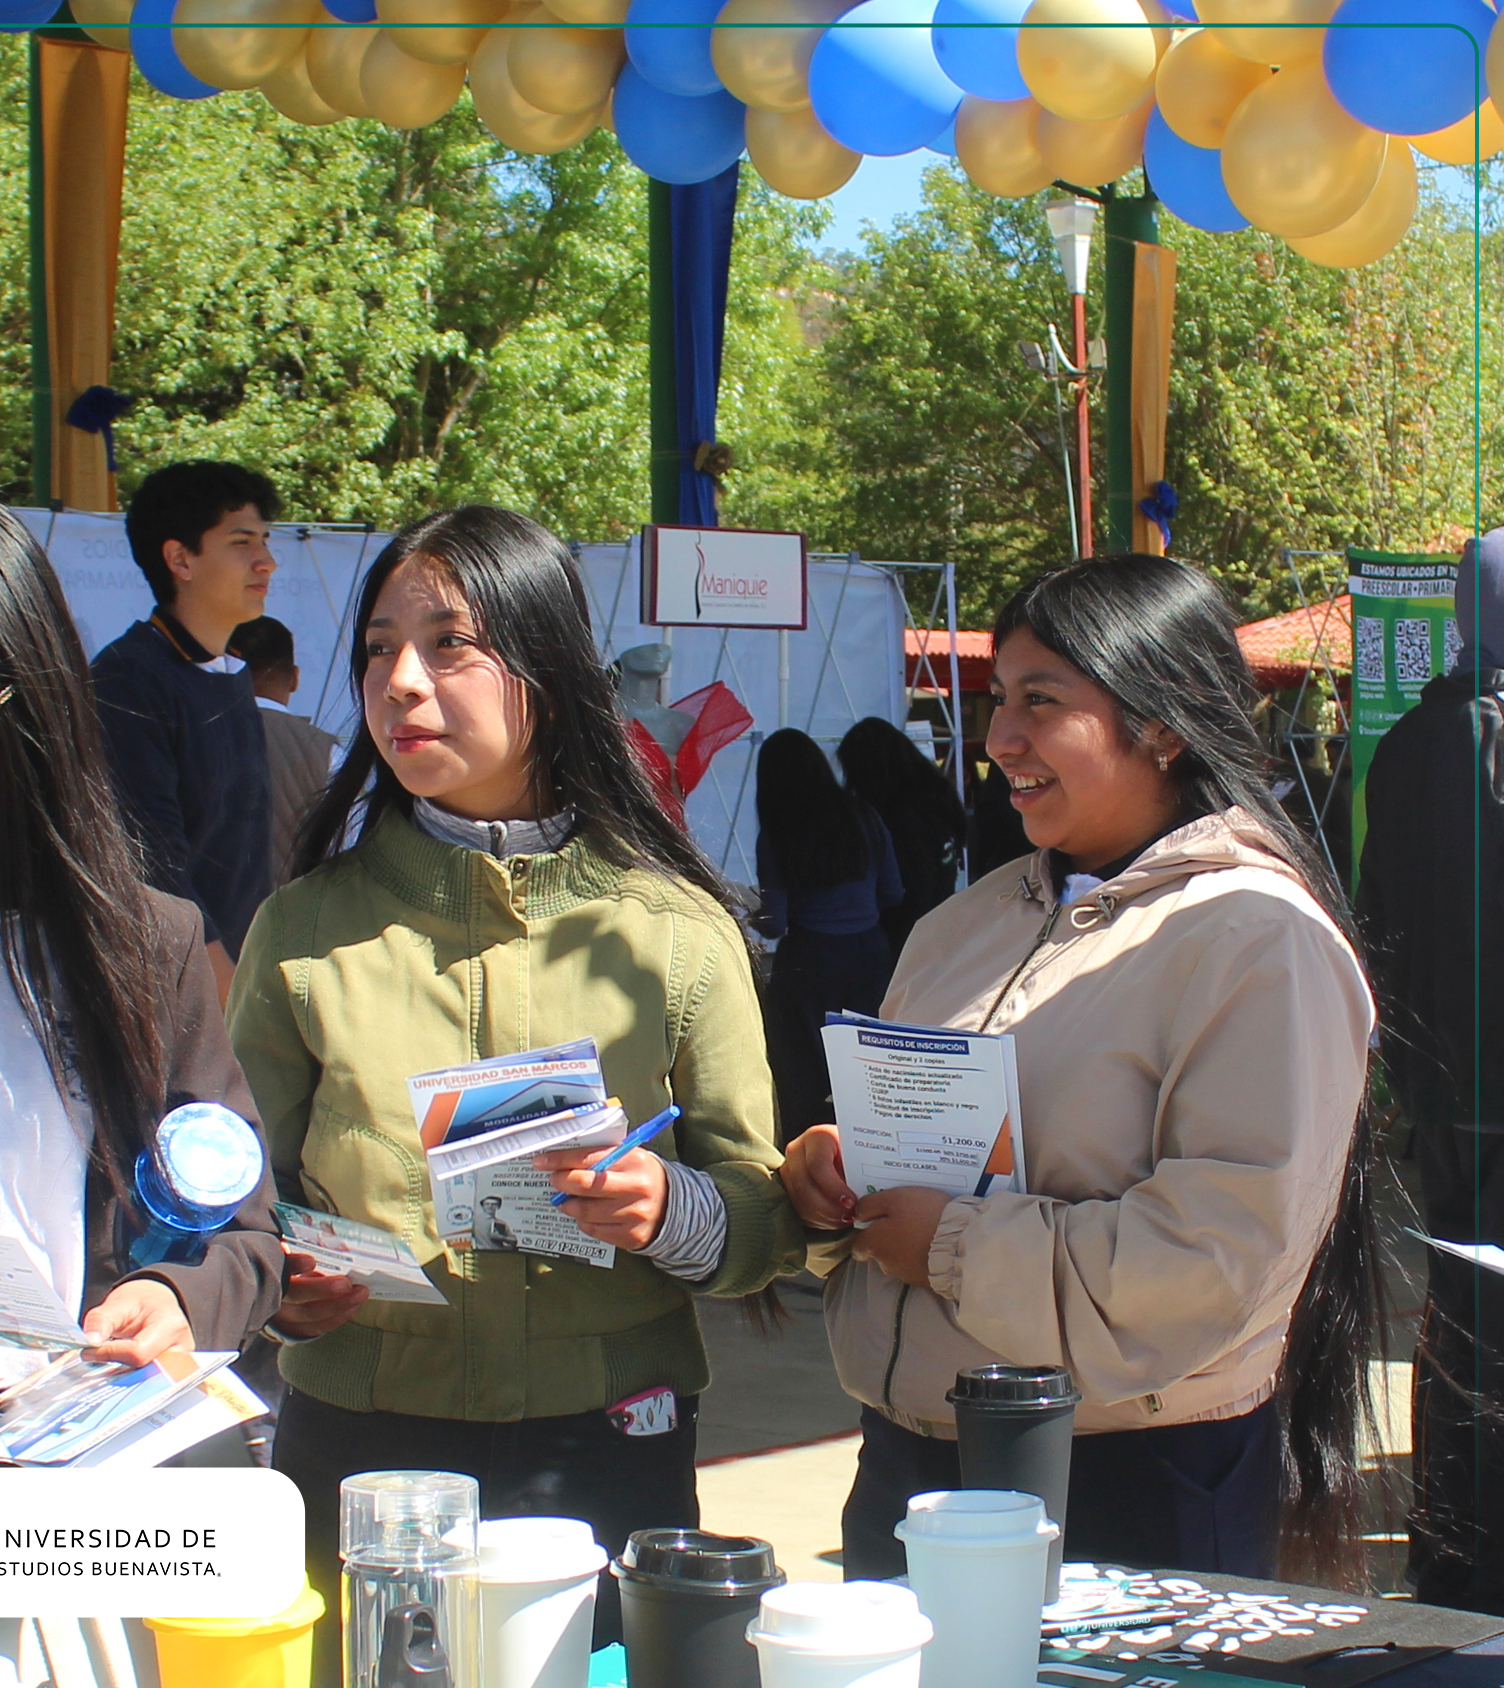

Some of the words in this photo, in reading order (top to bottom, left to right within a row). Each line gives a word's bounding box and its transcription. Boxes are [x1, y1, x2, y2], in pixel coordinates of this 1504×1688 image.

[1361, 563, 1395, 577] ESTAMOS
[1397, 566, 1435, 578] UBICADOS
[1437, 565, 1448, 577] EN
[701, 573, 768, 600] Maniquie
[1361, 579, 1412, 595] PREESCOLAR
[1418, 580, 1454, 596] PRIMARI
[862, 1035, 904, 1047] REQUISITOS
[917, 1042, 965, 1051] INSCRIPCIÓN
[888, 1054, 912, 1062] Original
[413, 1070, 498, 1089] UNIVERSIDAD
[502, 1065, 528, 1076] SAN
[531, 1061, 588, 1072] MARCOS
[484, 1111, 548, 1128] MODALIDAD
[942, 1136, 987, 1149] $1,200.00
[535, 1237, 558, 1250] 967
[559, 1242, 578, 1255] 125
[579, 1245, 607, 1259] 9951
